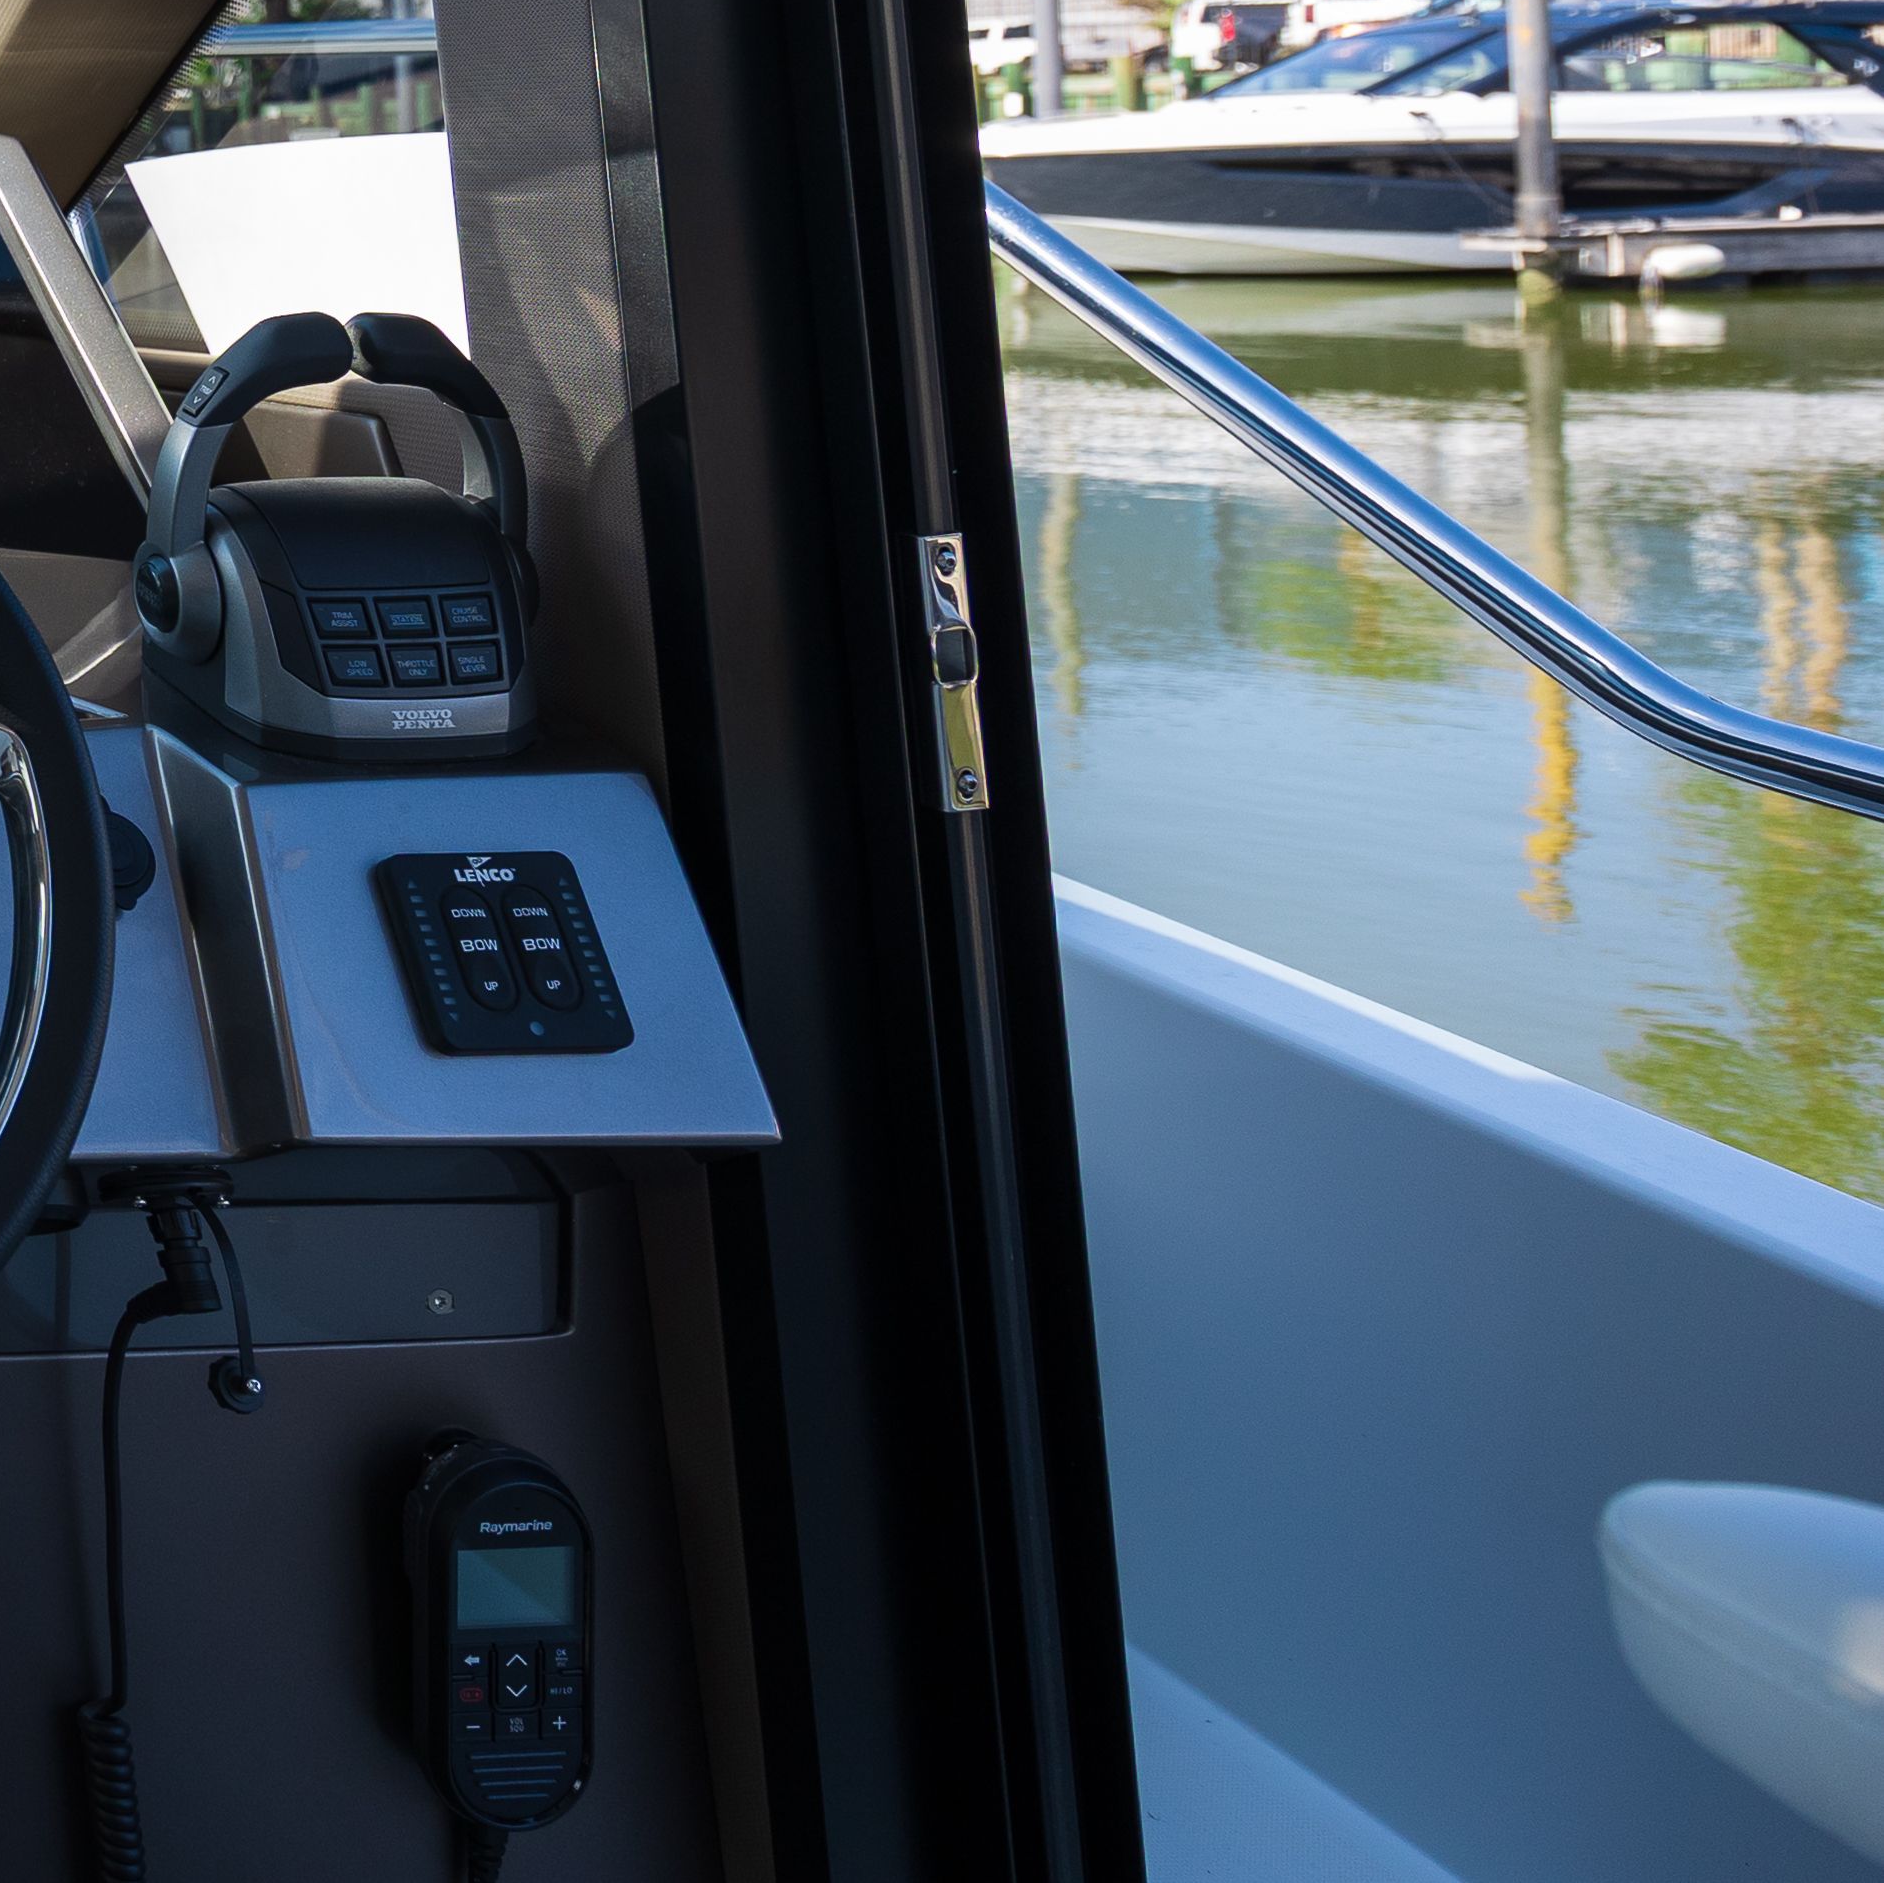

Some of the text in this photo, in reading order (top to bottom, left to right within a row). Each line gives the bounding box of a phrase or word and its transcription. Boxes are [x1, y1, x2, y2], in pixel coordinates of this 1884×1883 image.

[452, 606, 478, 615] CRUISE
[331, 619, 358, 627] ASSIST
[452, 615, 487, 624] CONTROL
[348, 660, 367, 668] LOW
[397, 660, 437, 668] THROTTLE
[457, 656, 485, 664] SINGLE
[346, 668, 373, 676] SPEED
[408, 668, 427, 676] ONLY
[461, 664, 487, 673] LEVER
[392, 708, 453, 719] VOLVO
[392, 718, 457, 730] PENTA
[451, 908, 487, 918] DOWN
[512, 907, 549, 917] DOWN
[460, 938, 498, 952] BOW
[522, 937, 561, 951] BOW
[484, 981, 499, 992] UP
[546, 979, 561, 990] UP
[479, 1519, 553, 1535] Raymarine
